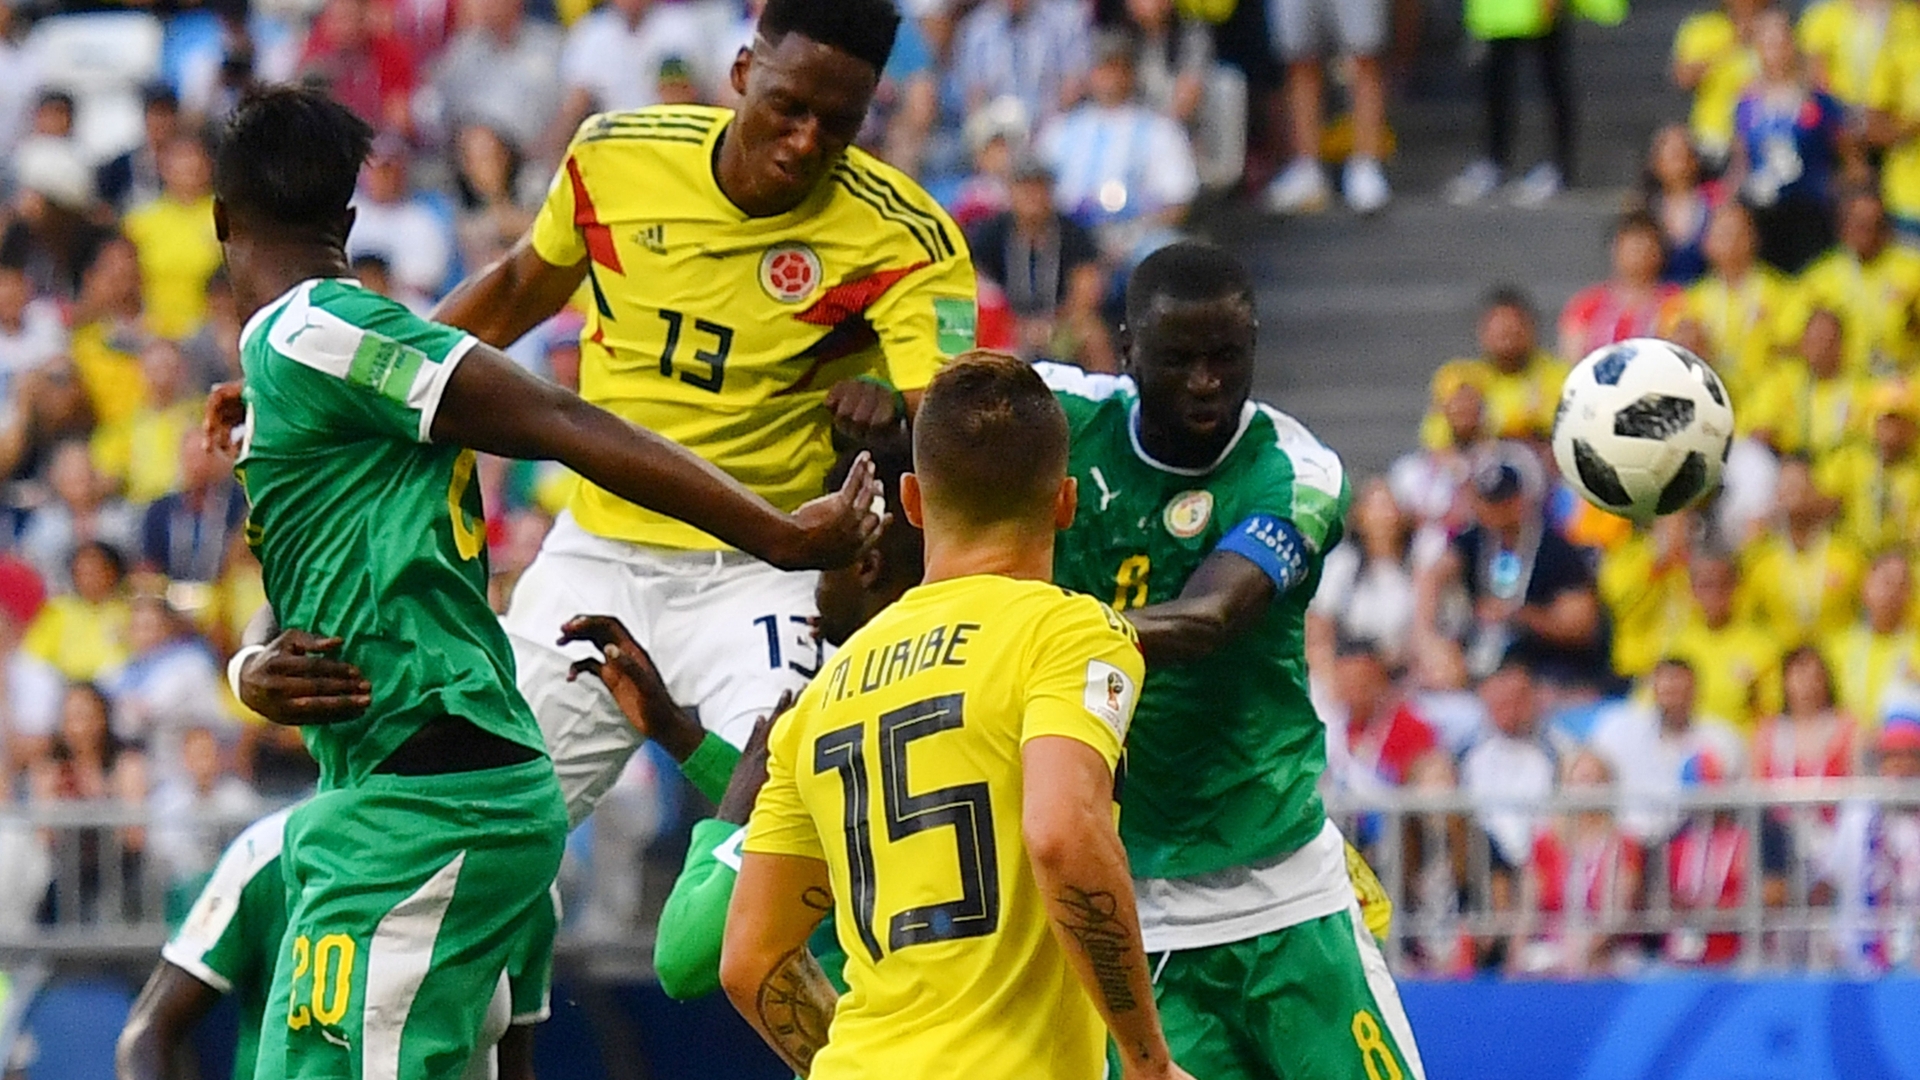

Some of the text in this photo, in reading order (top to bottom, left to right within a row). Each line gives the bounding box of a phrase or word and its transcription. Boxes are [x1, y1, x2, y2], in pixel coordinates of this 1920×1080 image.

[658, 308, 735, 394] 13
[753, 614, 824, 681] 13
[813, 692, 998, 964] 15
[287, 934, 356, 1031] 20
[1351, 1009, 1403, 1080] 8
